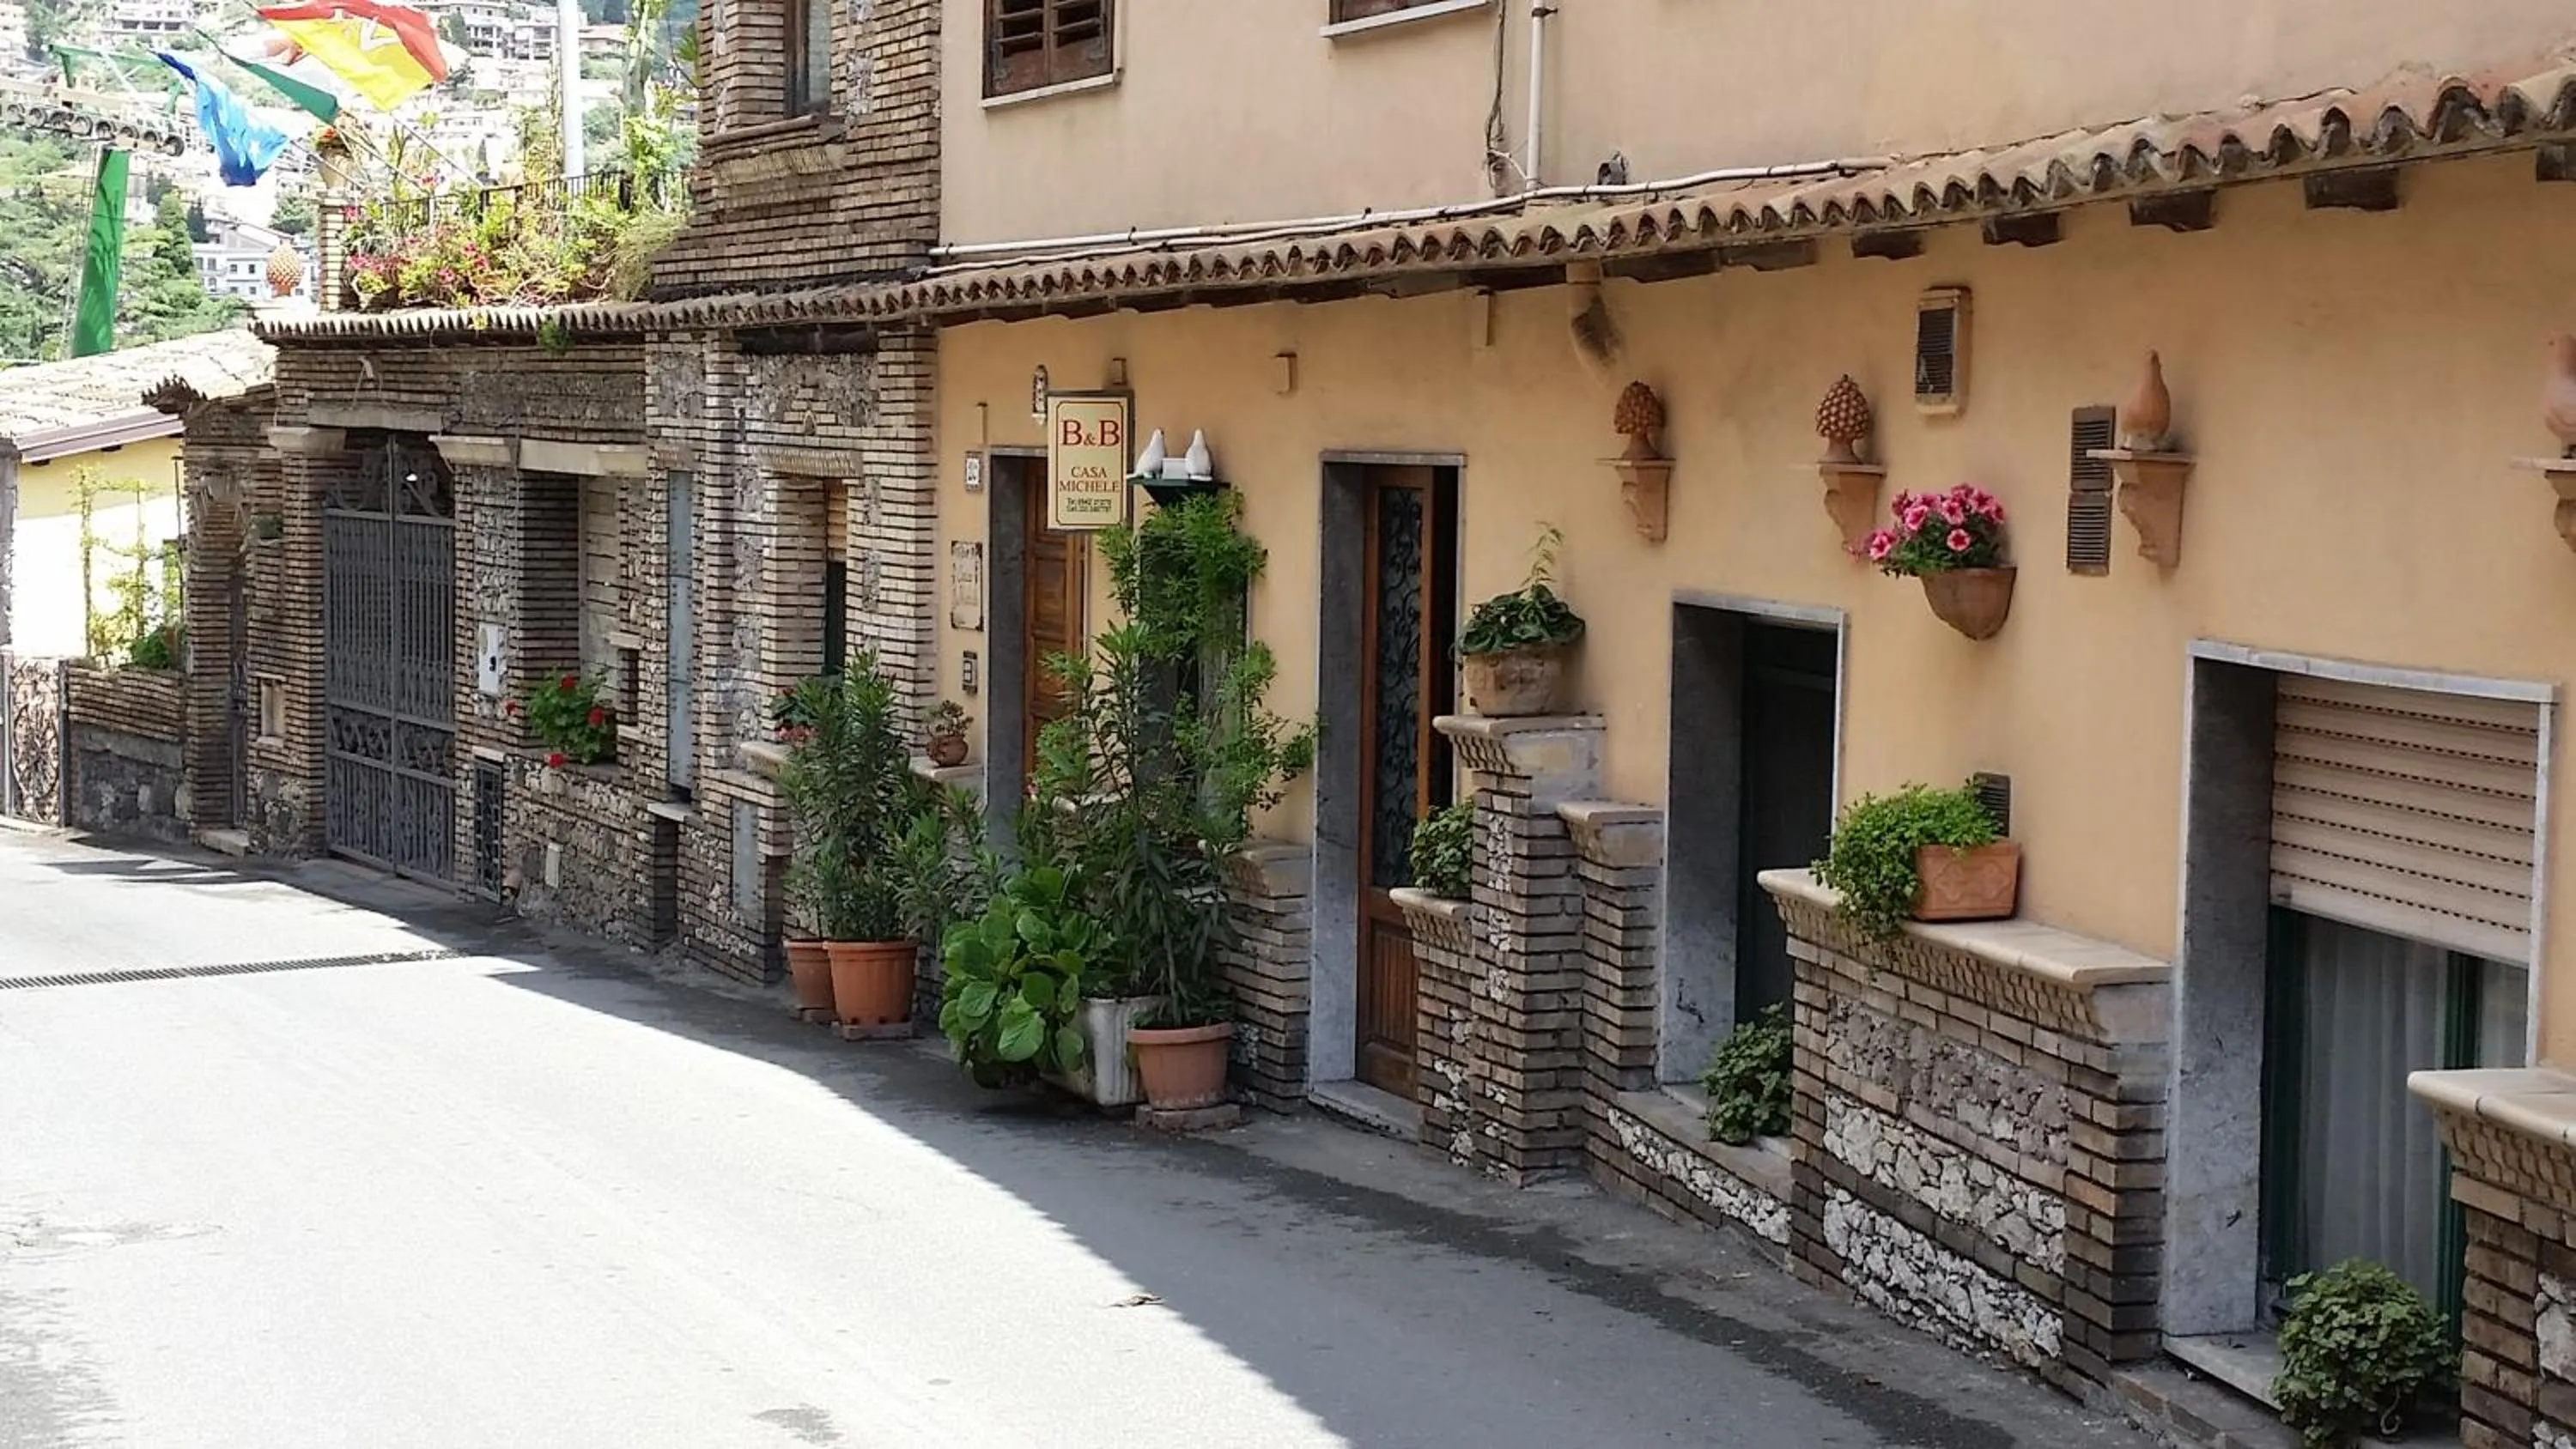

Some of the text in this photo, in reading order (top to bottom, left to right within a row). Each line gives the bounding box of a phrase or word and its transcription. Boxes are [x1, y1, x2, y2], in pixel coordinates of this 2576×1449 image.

[1061, 420, 1120, 446] B&B
[1071, 466, 1108, 478] CASA
[1059, 480, 1121, 493] MICHELE
